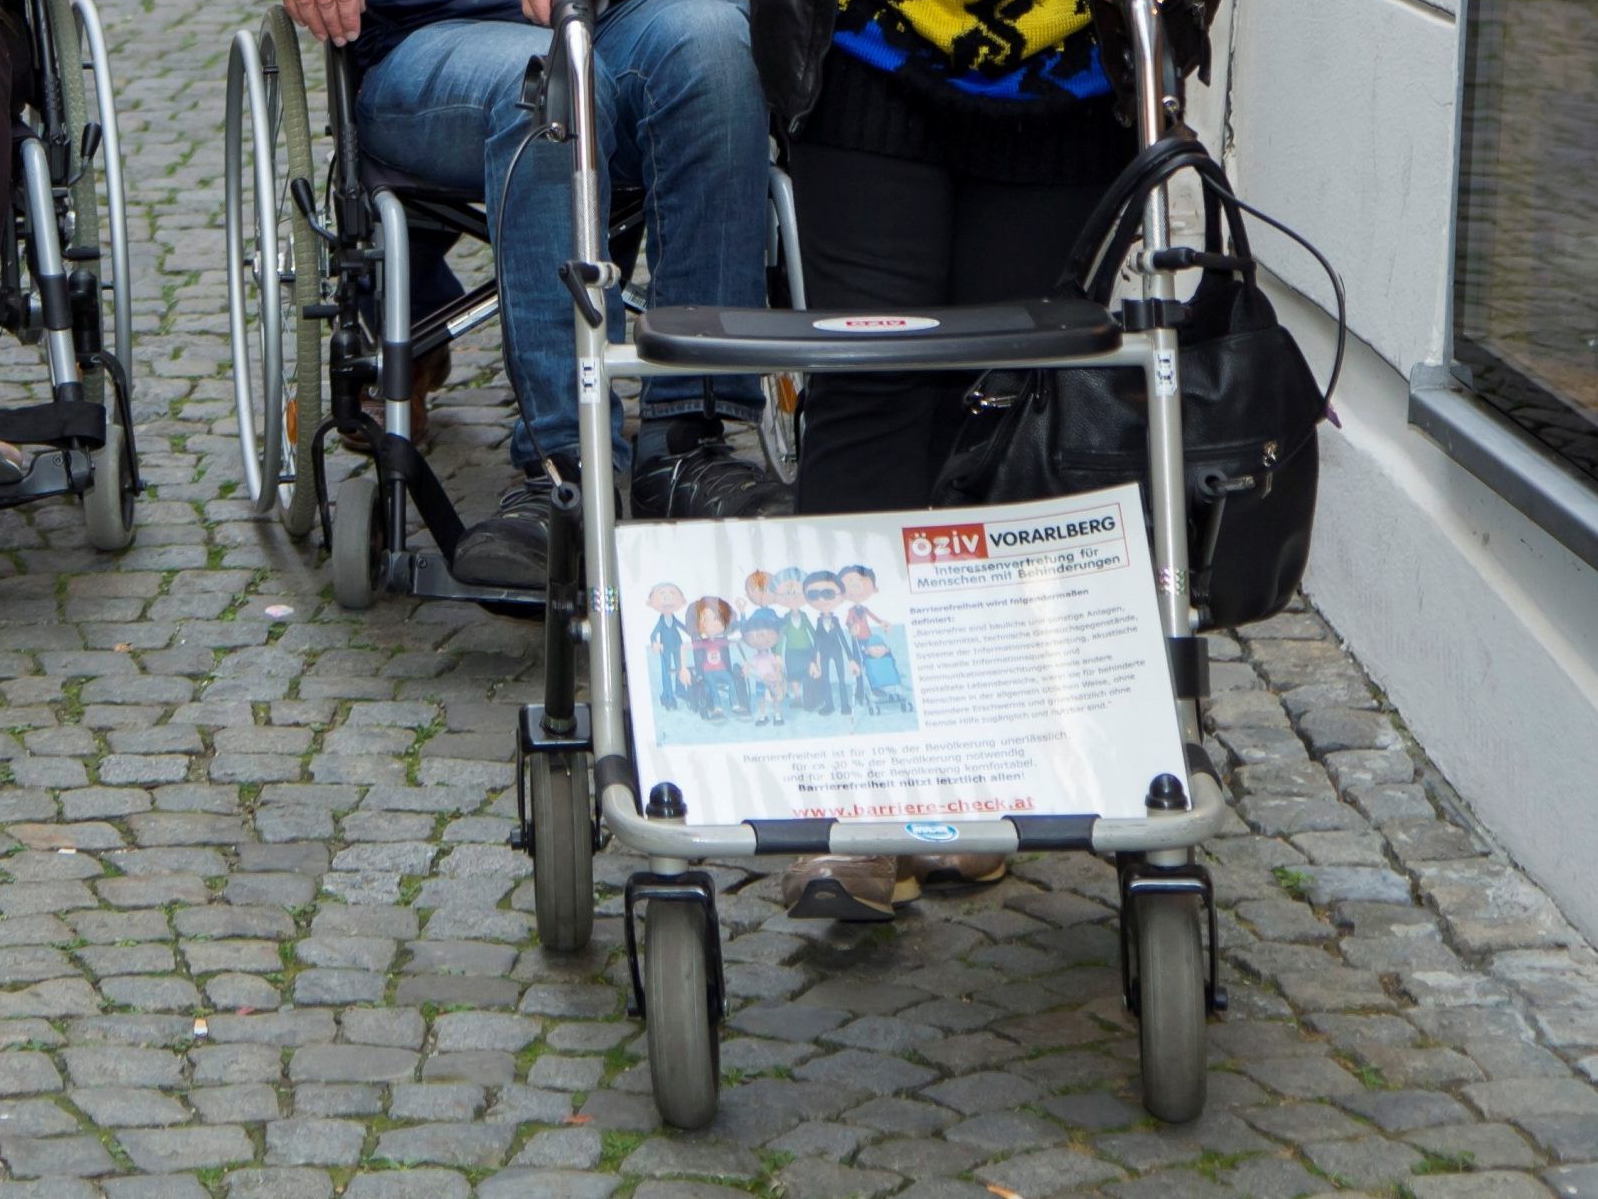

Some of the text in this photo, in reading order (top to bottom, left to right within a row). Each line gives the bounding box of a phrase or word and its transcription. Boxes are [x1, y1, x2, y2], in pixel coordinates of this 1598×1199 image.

[989, 516, 1116, 548] VORARLBERG
[917, 555, 1121, 589] Menschen mit Behinderungen
[935, 548, 1099, 576] Interessenvertretung für
[910, 589, 1089, 615] Barrierefreiheit wird folgendermaßen
[1087, 605, 1126, 617] Anlagen,
[911, 616, 955, 626] definiert:
[1098, 659, 1146, 675] behinderte
[743, 751, 826, 763] Barrierefreiheit
[832, 749, 845, 758] ist
[850, 747, 865, 758] für
[872, 745, 898, 756] 10%
[902, 744, 920, 753] der
[925, 740, 996, 752] Bevölkerung
[792, 762, 807, 771] für
[868, 757, 886, 767] der
[891, 753, 962, 766] Bevölkerung
[966, 748, 1025, 762] notwendig
[783, 772, 805, 783] und
[867, 768, 886, 778] der
[891, 763, 960, 776] Bevölkerung
[965, 759, 1038, 772] komfortabel.
[798, 773, 1026, 792] Barrierefreiheit nützt letztlich allen!
[792, 795, 1035, 818] www.barriere-check.at
